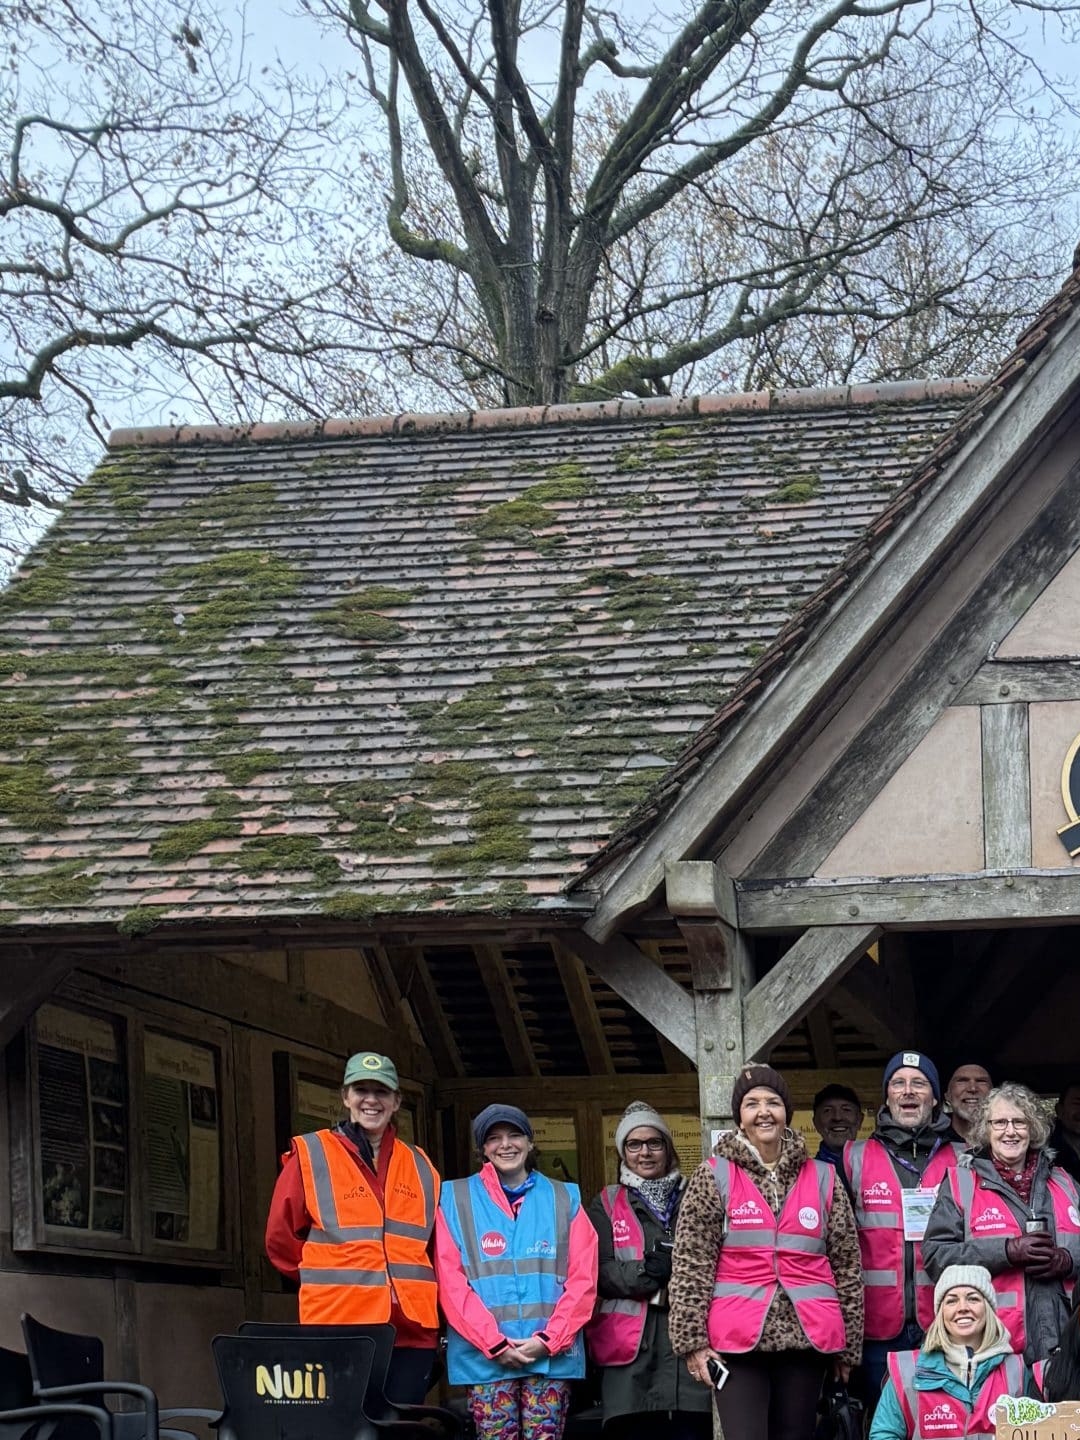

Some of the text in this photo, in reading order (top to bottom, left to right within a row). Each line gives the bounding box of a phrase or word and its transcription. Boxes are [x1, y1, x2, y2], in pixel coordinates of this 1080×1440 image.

[481, 1237, 507, 1250] Vitality
[256, 1363, 326, 1399] Nuii
[923, 1410, 957, 1422] parkrun
